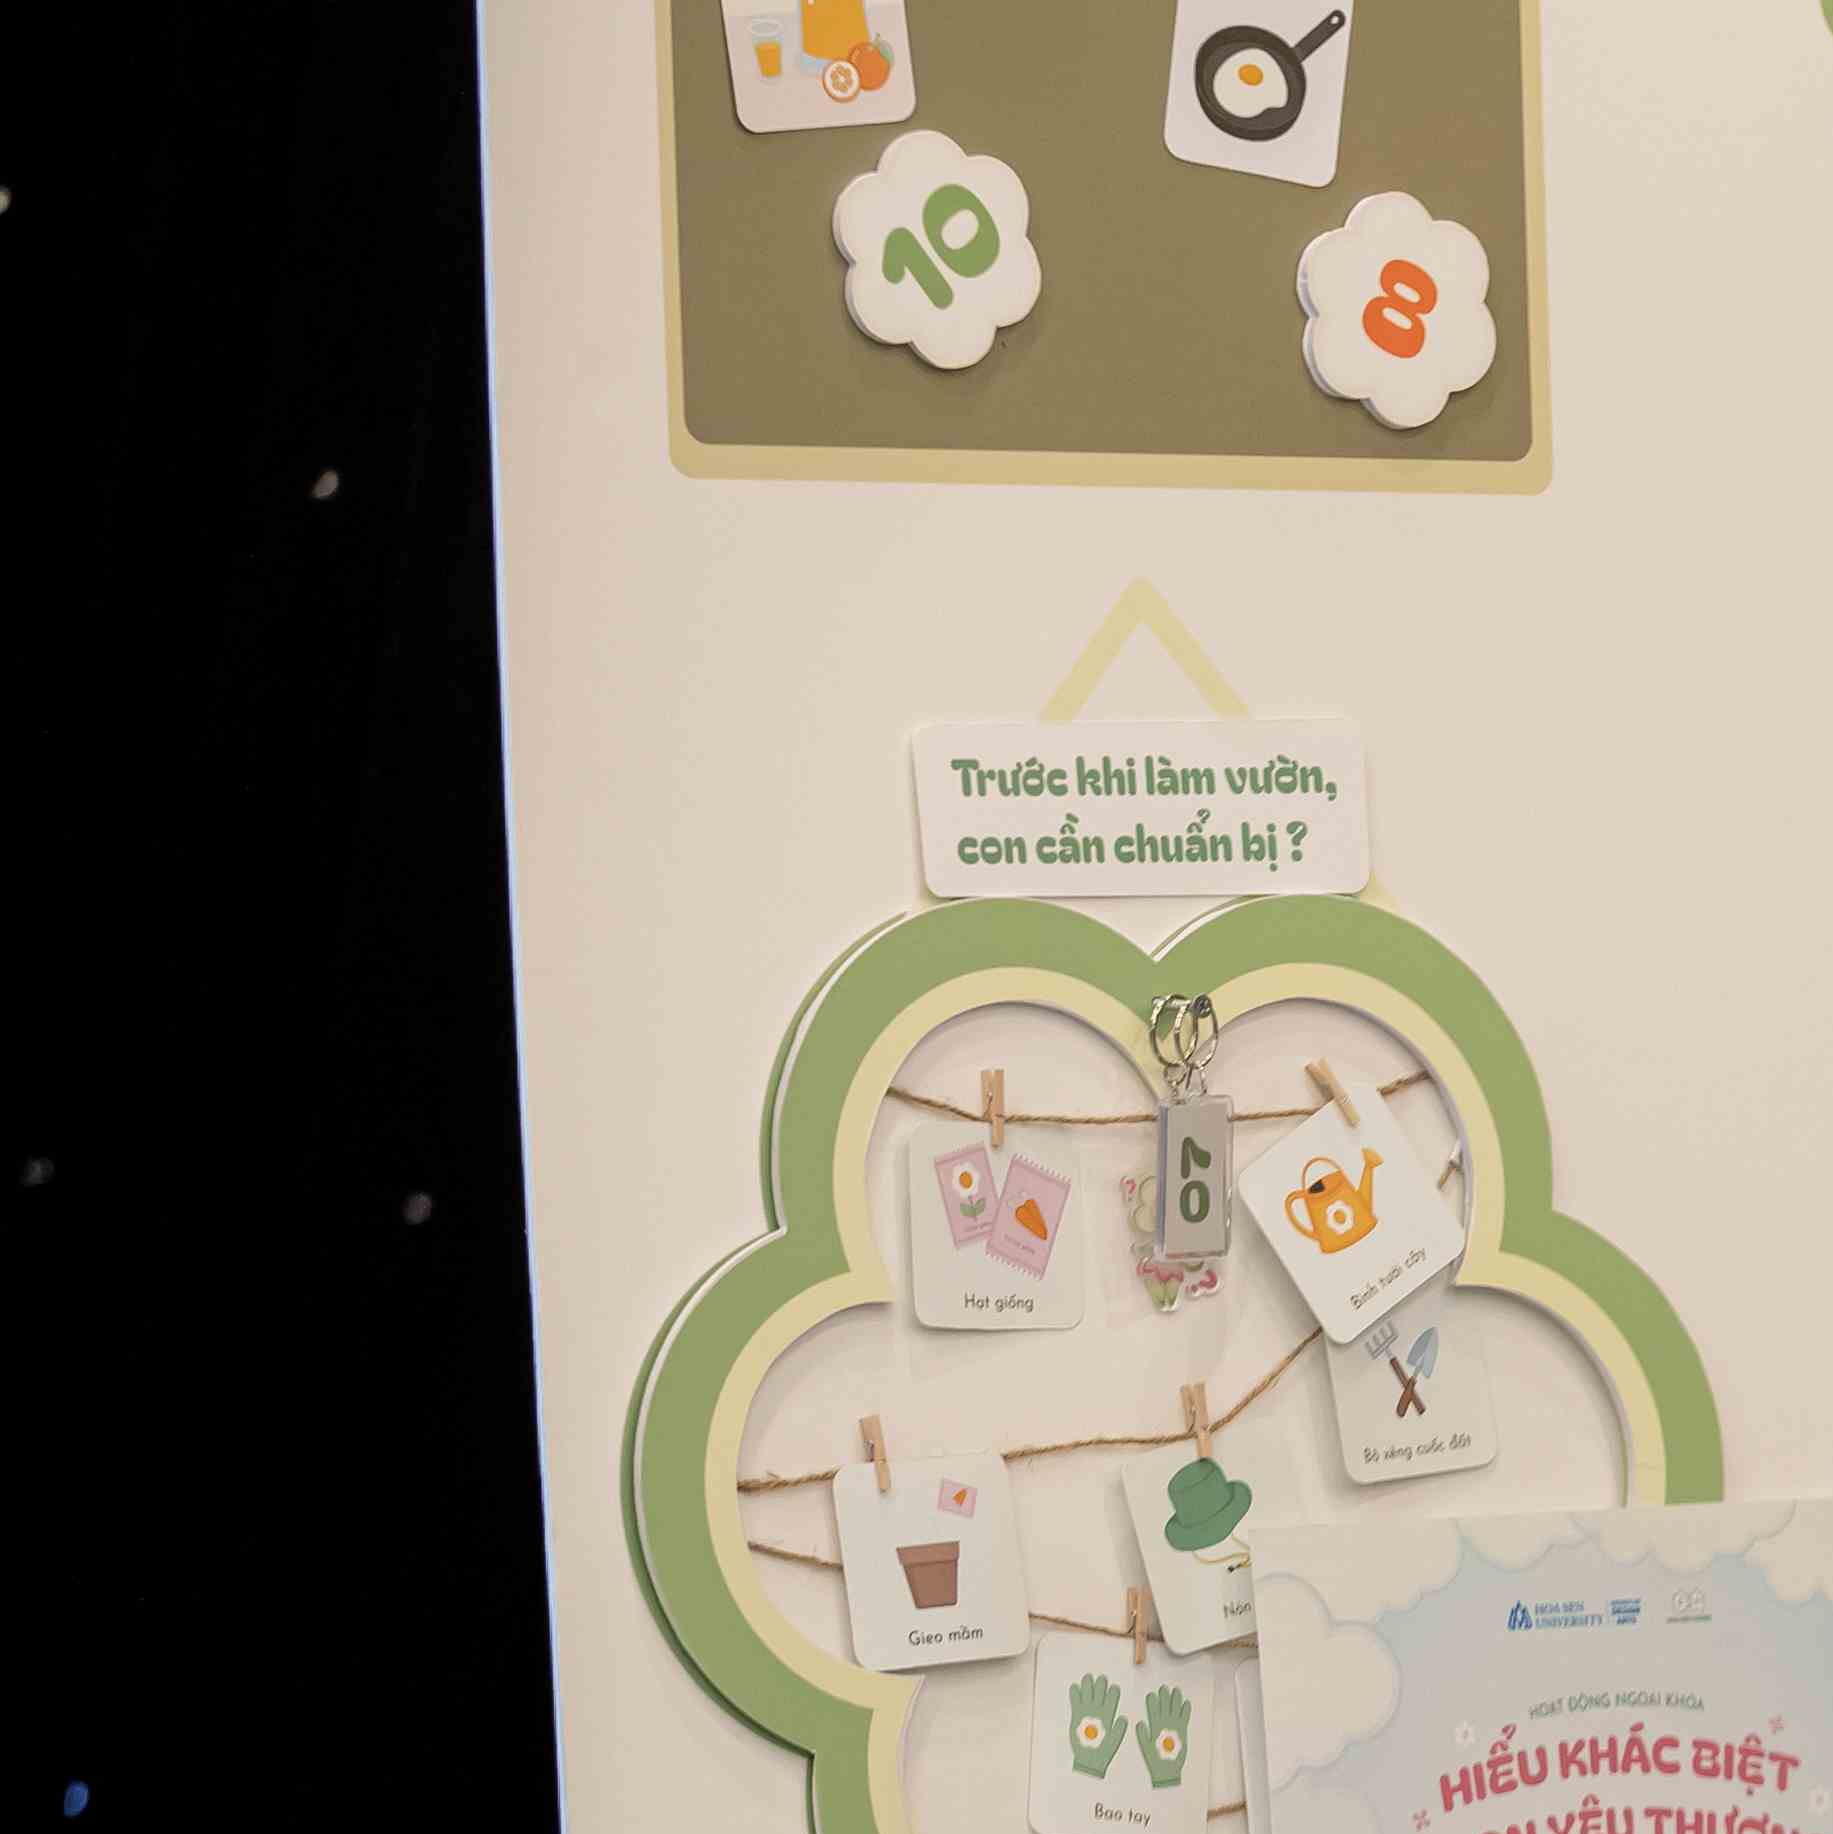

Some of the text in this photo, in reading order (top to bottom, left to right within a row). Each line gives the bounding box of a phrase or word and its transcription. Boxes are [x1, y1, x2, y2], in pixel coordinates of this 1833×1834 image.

[881, 184, 1001, 309] 10
[1362, 259, 1439, 359] 8
[951, 755, 1338, 802] Trước khi làm vườn,
[957, 808, 1308, 872] con cần chuẩn bị ?
[994, 1294, 1035, 1313] giống
[908, 1630, 943, 1648] Gieo
[1438, 1720, 1801, 1813] HIỂU KHÁC BIỆT
[1094, 1802, 1151, 1826] Bao tay
